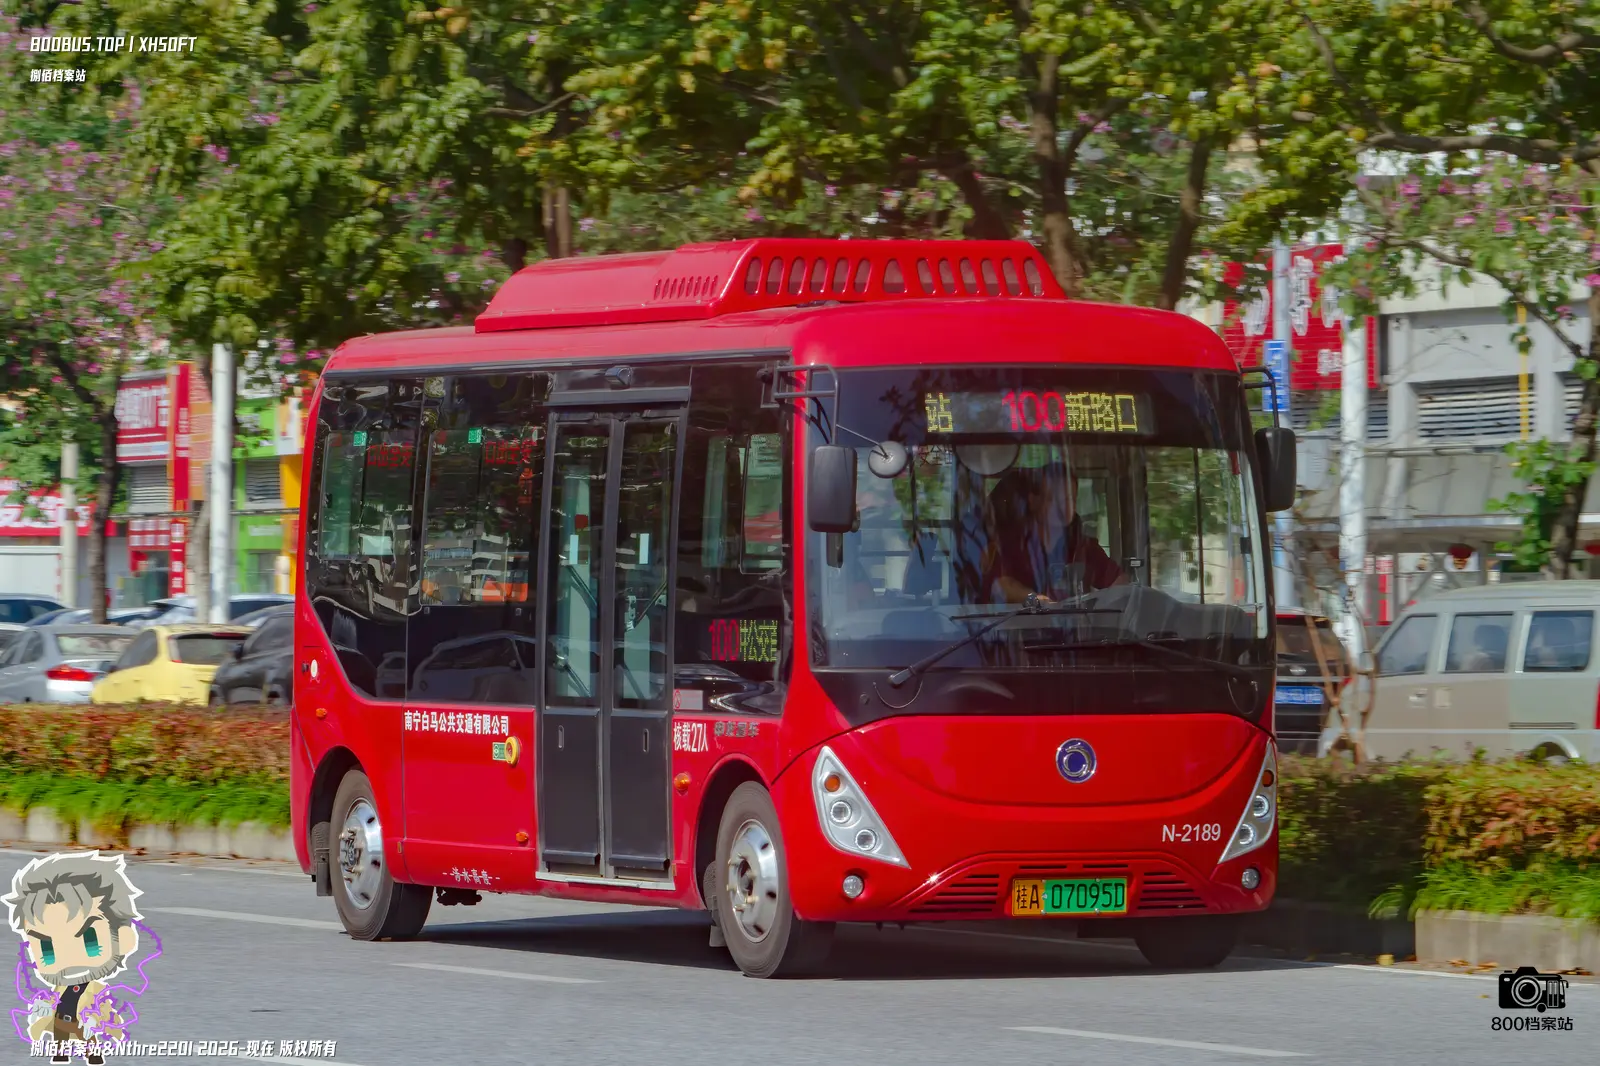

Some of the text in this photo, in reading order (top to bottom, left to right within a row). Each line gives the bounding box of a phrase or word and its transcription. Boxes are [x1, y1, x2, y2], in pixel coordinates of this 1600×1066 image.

[925, 391, 1138, 432] 站 100 新路口
[709, 619, 738, 661] 100
[404, 710, 509, 736] 南宁白马公共交通有限公司
[674, 722, 708, 752] 核载27人
[1161, 824, 1221, 842] N-2189
